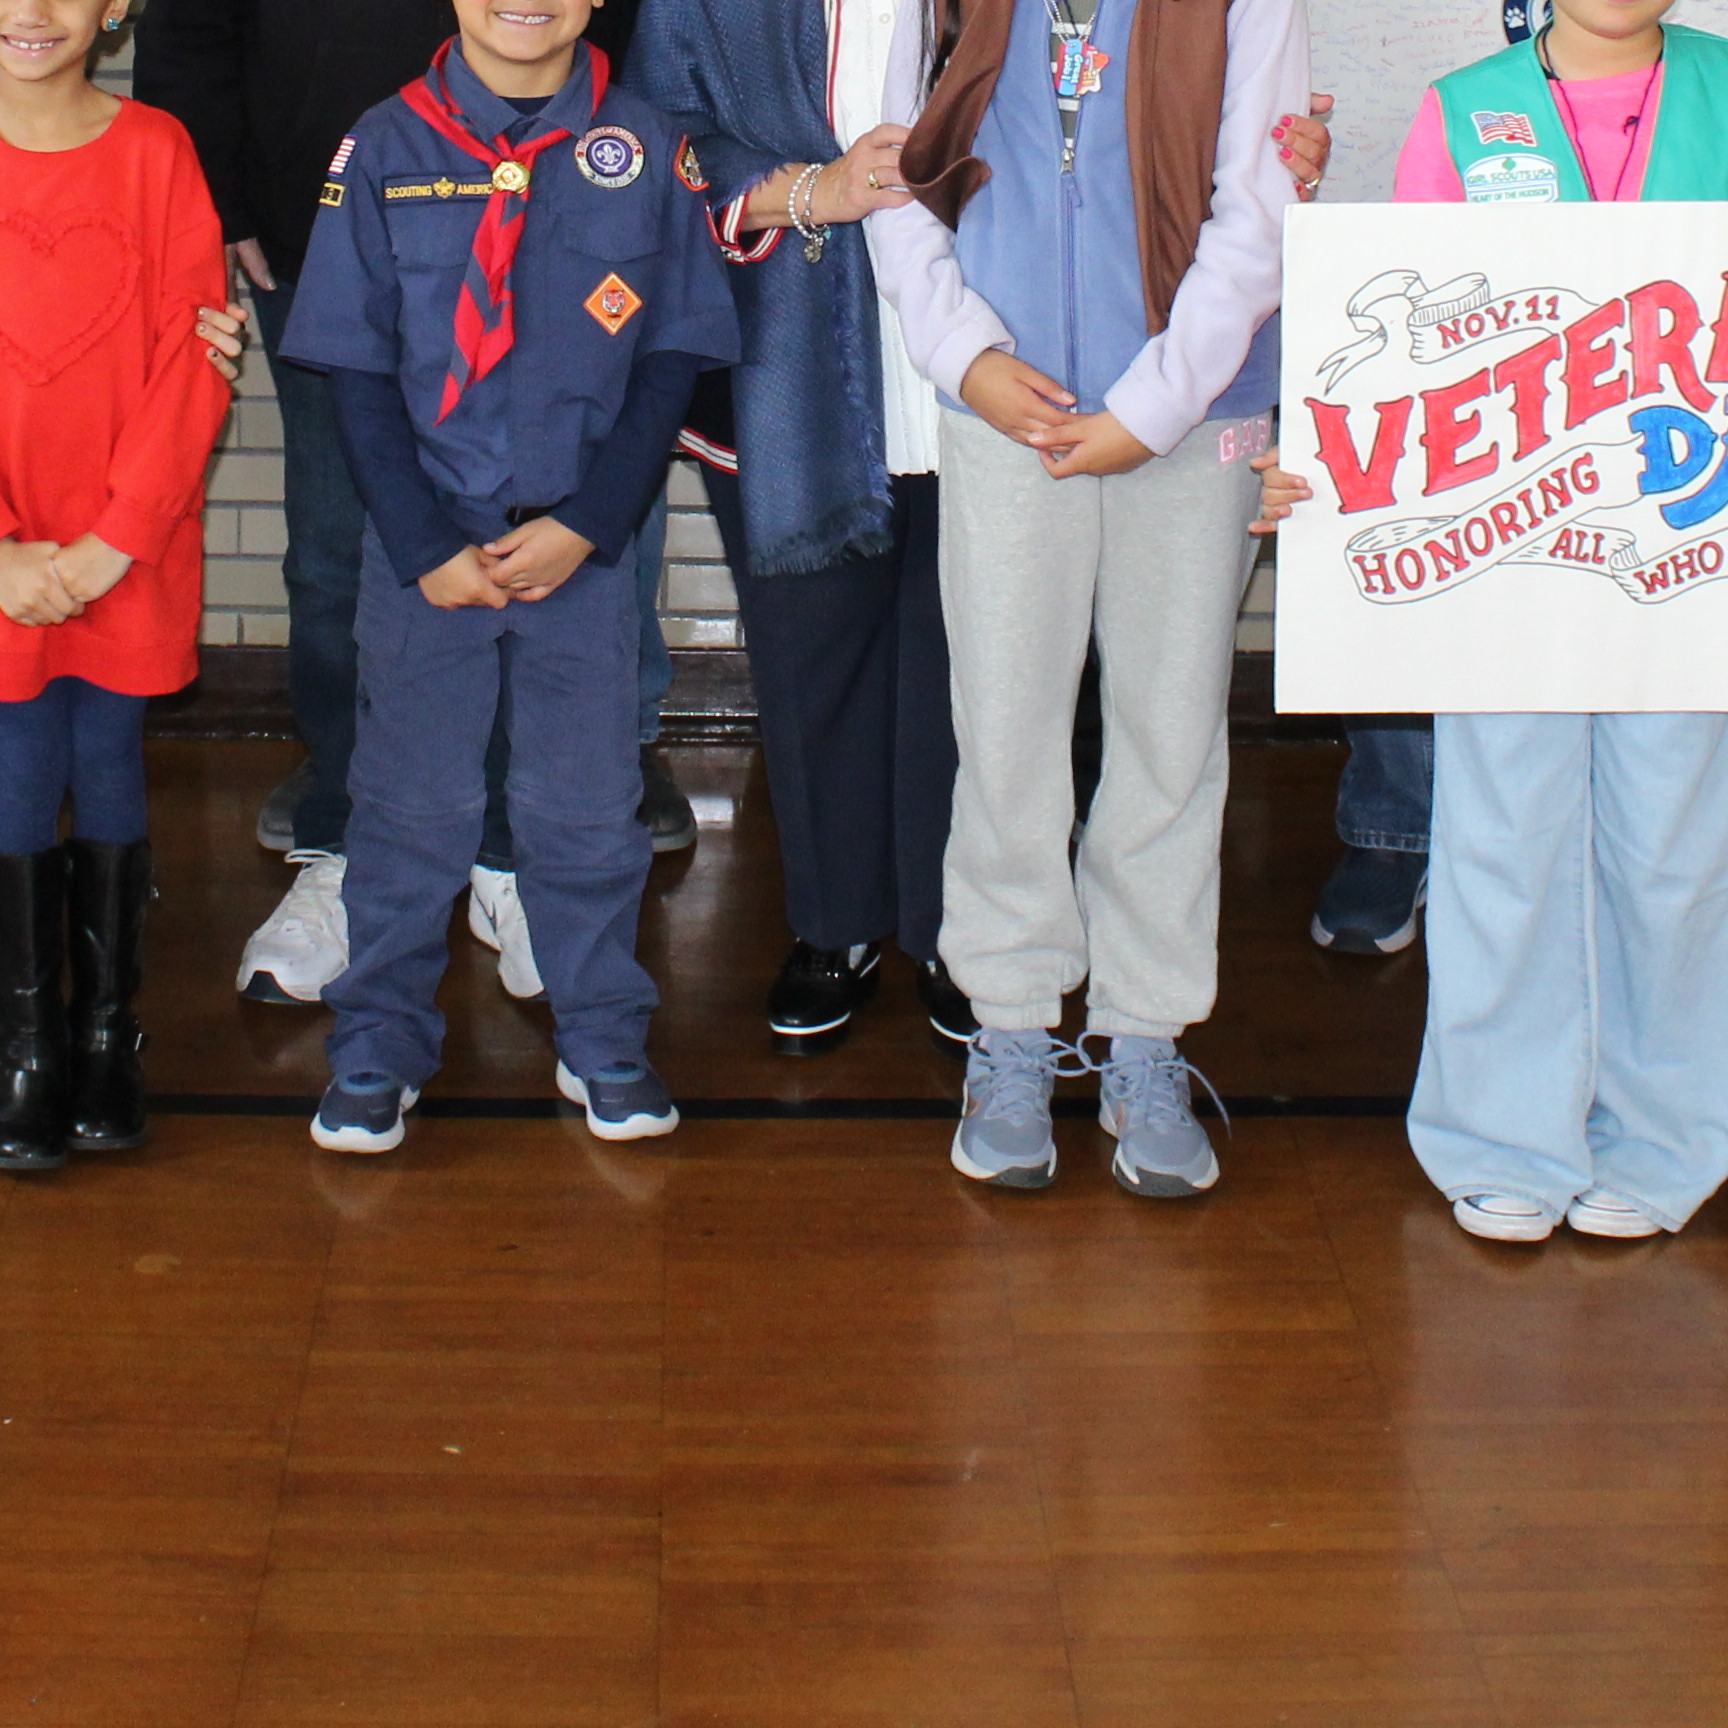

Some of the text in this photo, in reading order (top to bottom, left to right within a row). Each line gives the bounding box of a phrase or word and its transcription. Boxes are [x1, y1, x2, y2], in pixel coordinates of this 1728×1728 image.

[385, 184, 432, 199] SCOUTING
[1436, 294, 1561, 349] NOV. 11
[1354, 452, 1601, 599] HONORING
[1549, 527, 1607, 566] ALL
[1634, 539, 1726, 596] WHO
